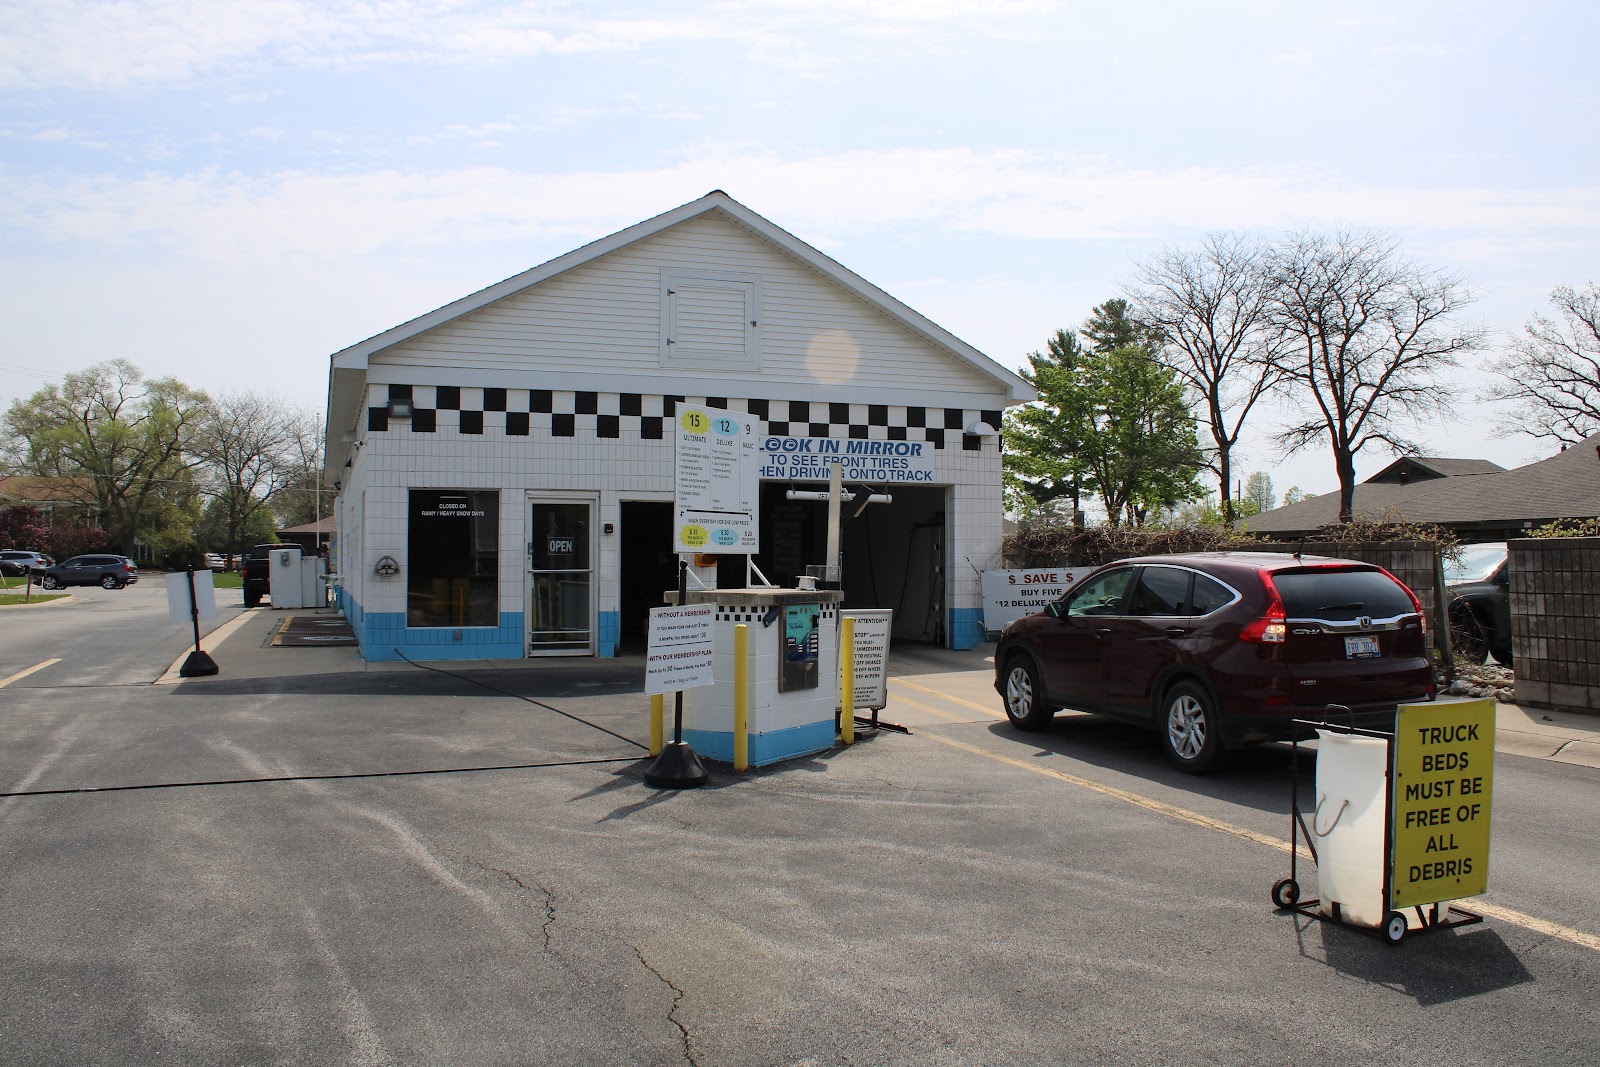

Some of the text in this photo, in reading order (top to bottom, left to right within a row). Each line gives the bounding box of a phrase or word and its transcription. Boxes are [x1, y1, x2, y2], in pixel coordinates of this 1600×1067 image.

[683, 434, 707, 444] ULTIMATE
[818, 439, 840, 454] IN
[846, 441, 923, 457] MIRROR
[769, 454, 787, 466] TO
[791, 455, 818, 466] SEE
[872, 457, 909, 469] TIRES
[849, 469, 887, 480] ONTO
[890, 470, 932, 481] TRACK
[550, 540, 572, 552] OPEN
[1008, 572, 1074, 585] $ SAVE $
[1021, 588, 1063, 597] BUY FIVE
[662, 653, 673, 661] OUR
[1419, 723, 1479, 745] TRUCK
[1422, 751, 1469, 773] BEDS
[1406, 777, 1482, 801] MUST BE
[1406, 803, 1481, 829] FREE OF
[1425, 833, 1459, 853] ALL
[1409, 857, 1473, 883] DEBRIS
